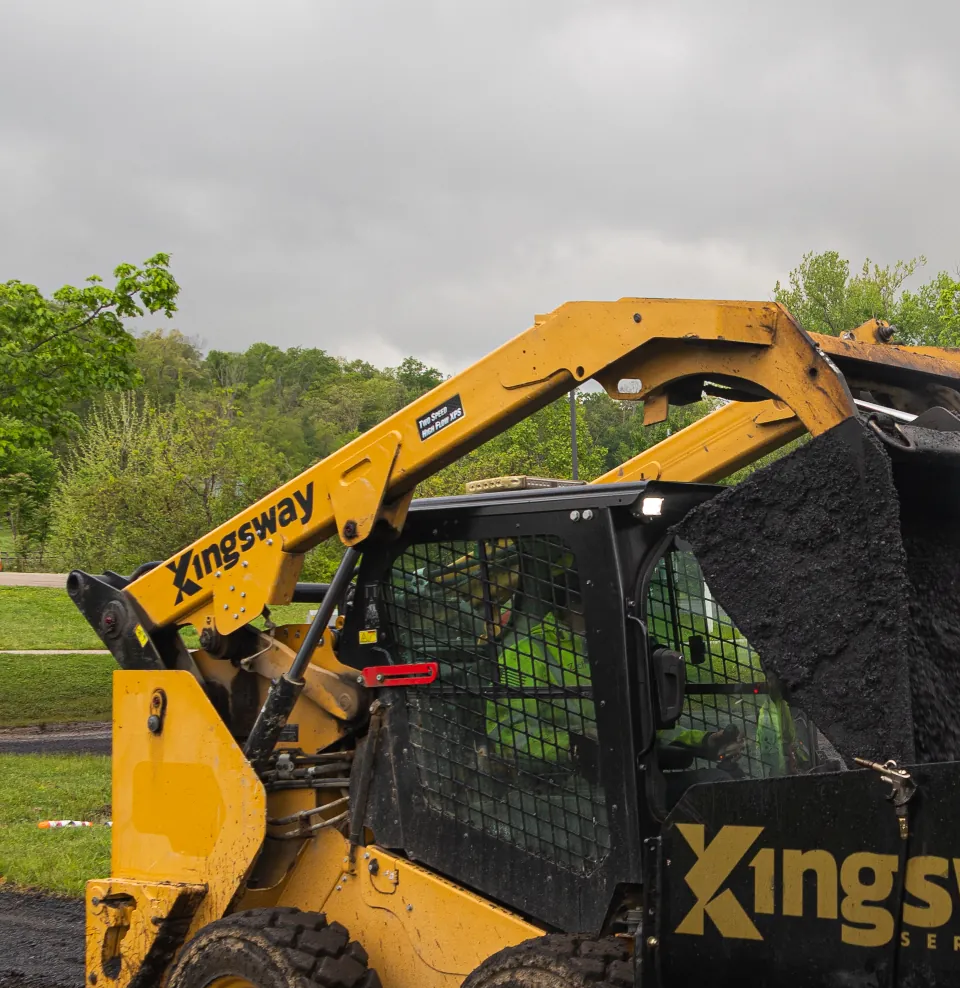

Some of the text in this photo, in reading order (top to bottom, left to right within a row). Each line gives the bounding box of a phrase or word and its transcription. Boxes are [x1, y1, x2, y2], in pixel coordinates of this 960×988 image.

[431, 406, 448, 421] SPEED
[435, 416, 450, 430] FLOW
[450, 407, 462, 421] XPS
[165, 481, 314, 606] Kingsway
